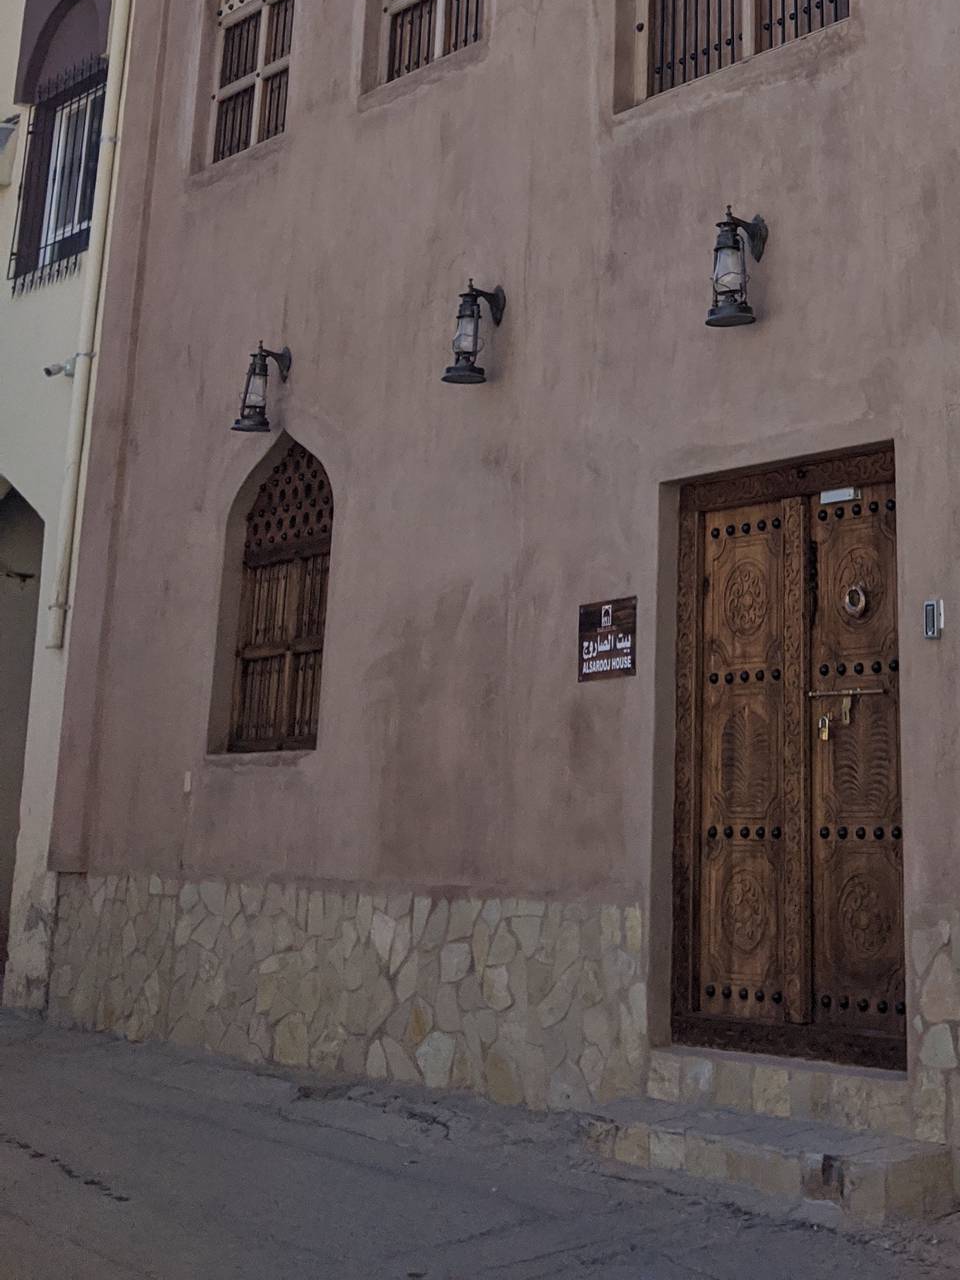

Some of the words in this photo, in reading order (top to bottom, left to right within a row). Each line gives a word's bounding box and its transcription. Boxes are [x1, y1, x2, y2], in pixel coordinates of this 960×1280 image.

[583, 634, 614, 659] الصاروج
[616, 633, 631, 653] بيت
[582, 659, 611, 674] ALSAROOJ
[612, 656, 632, 669] HOUSE
